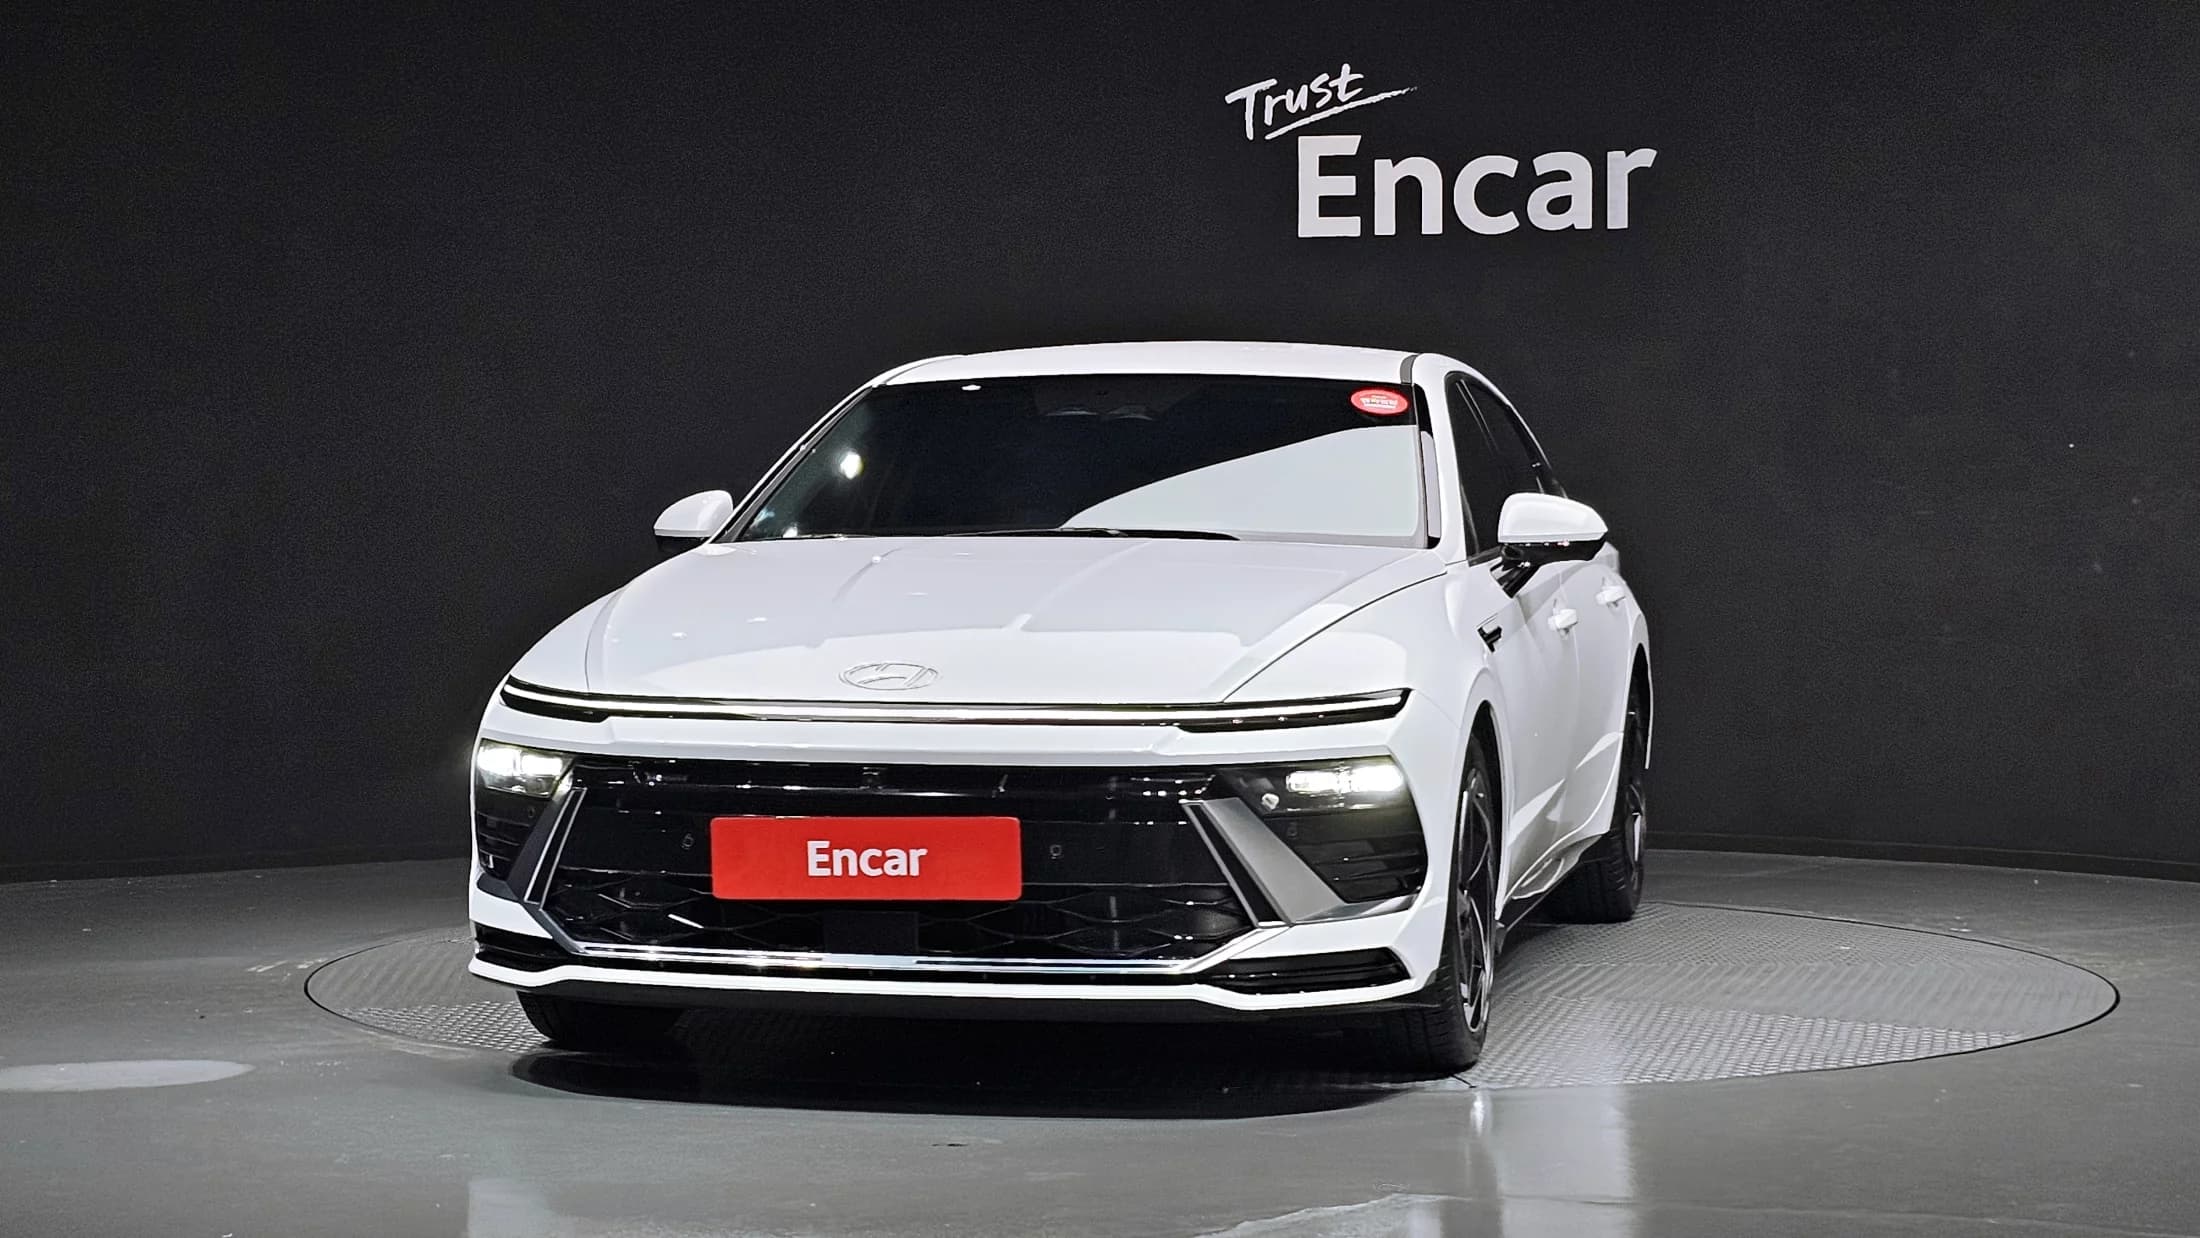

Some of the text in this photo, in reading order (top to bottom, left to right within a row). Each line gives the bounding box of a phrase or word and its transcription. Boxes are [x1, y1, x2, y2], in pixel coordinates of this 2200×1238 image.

[1225, 63, 1364, 140] Trust
[1297, 135, 1658, 238] Encar
[807, 840, 928, 878] Encar
